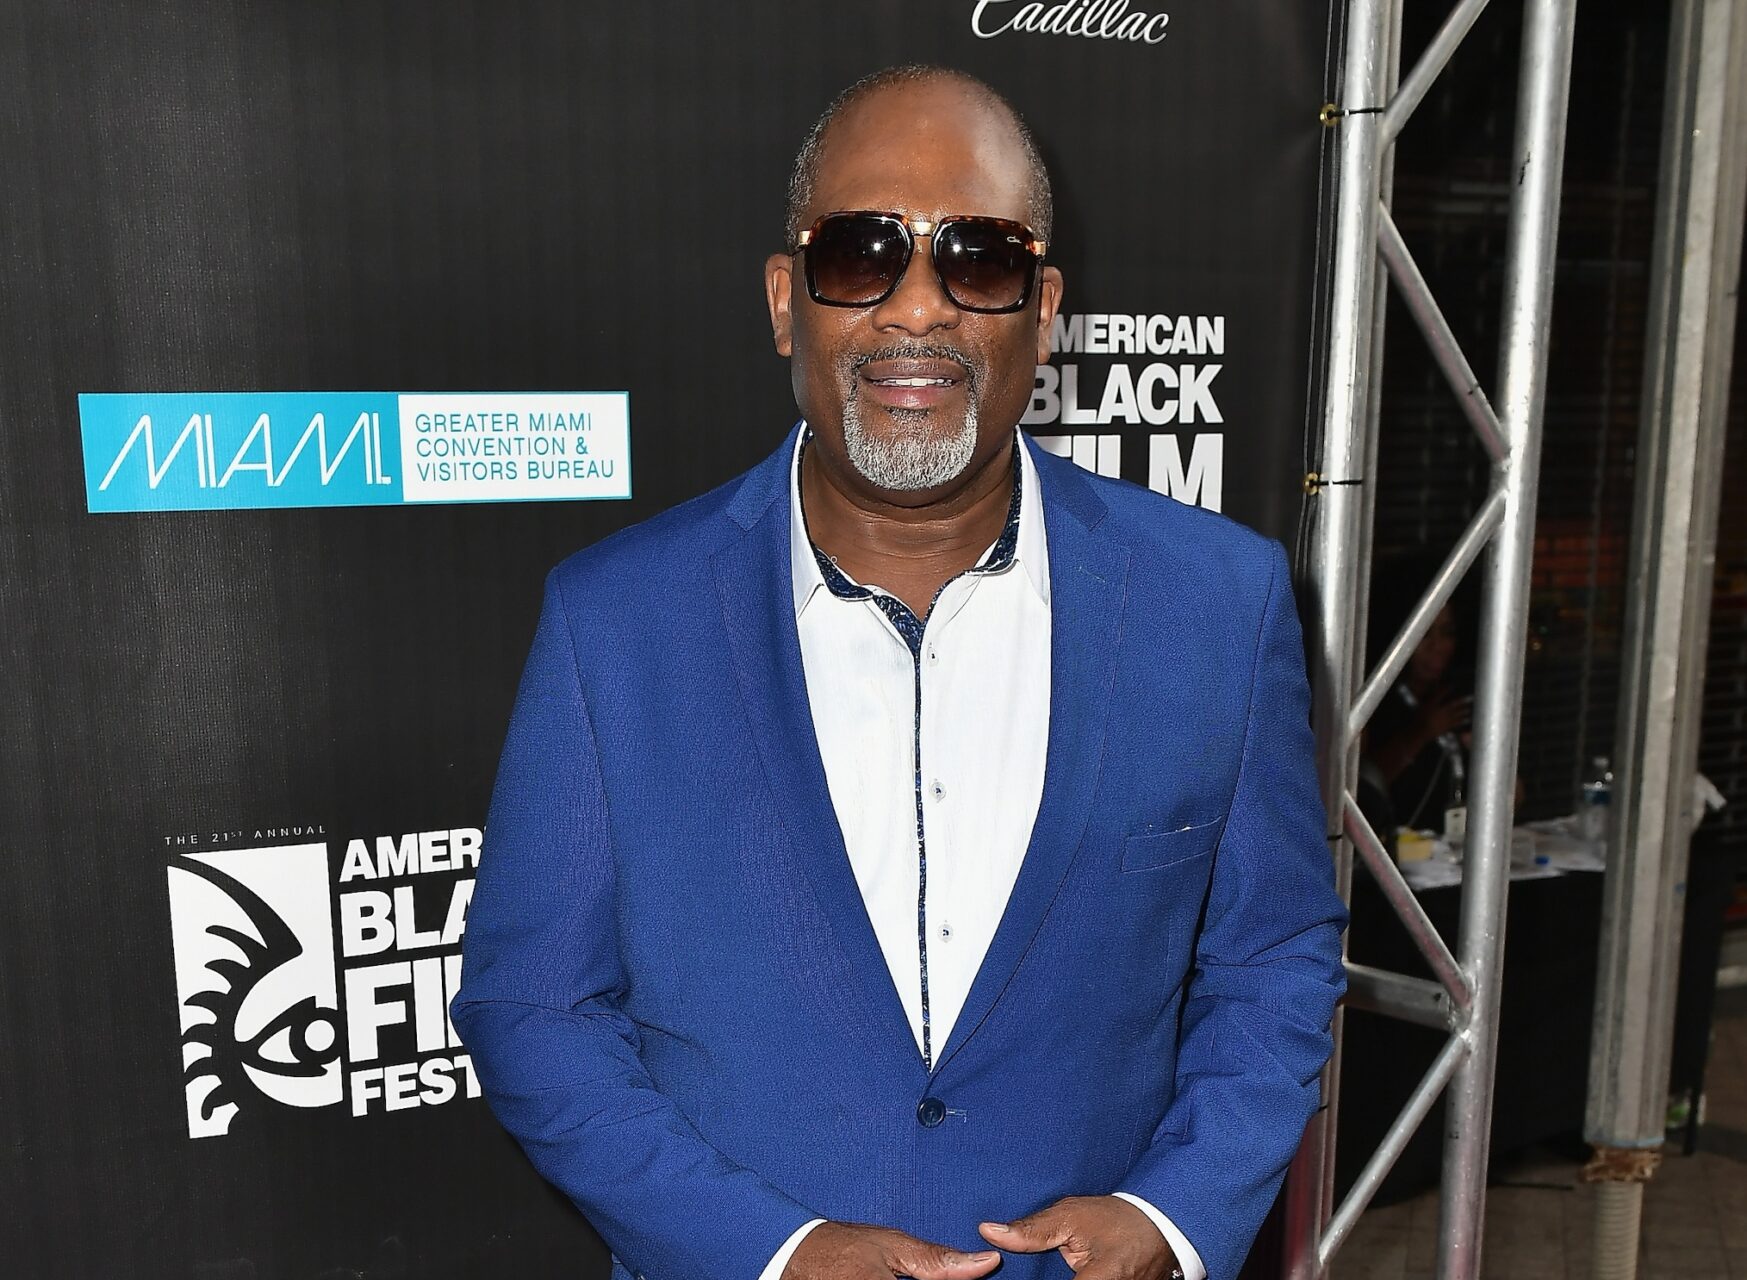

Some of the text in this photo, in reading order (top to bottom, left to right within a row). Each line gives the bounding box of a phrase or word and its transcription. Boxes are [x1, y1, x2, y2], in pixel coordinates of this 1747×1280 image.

[971, 0, 1169, 44] Cadillac
[1051, 314, 1225, 355] MERICAN
[1018, 362, 1224, 425] BLACK
[415, 412, 592, 432] GREATER MIAMI
[416, 436, 588, 457] CONVENTION &
[417, 459, 614, 482] VISITORS BUREAU
[164, 834, 198, 846] THE
[254, 825, 326, 839] ANNUAL
[339, 826, 487, 882] AMER
